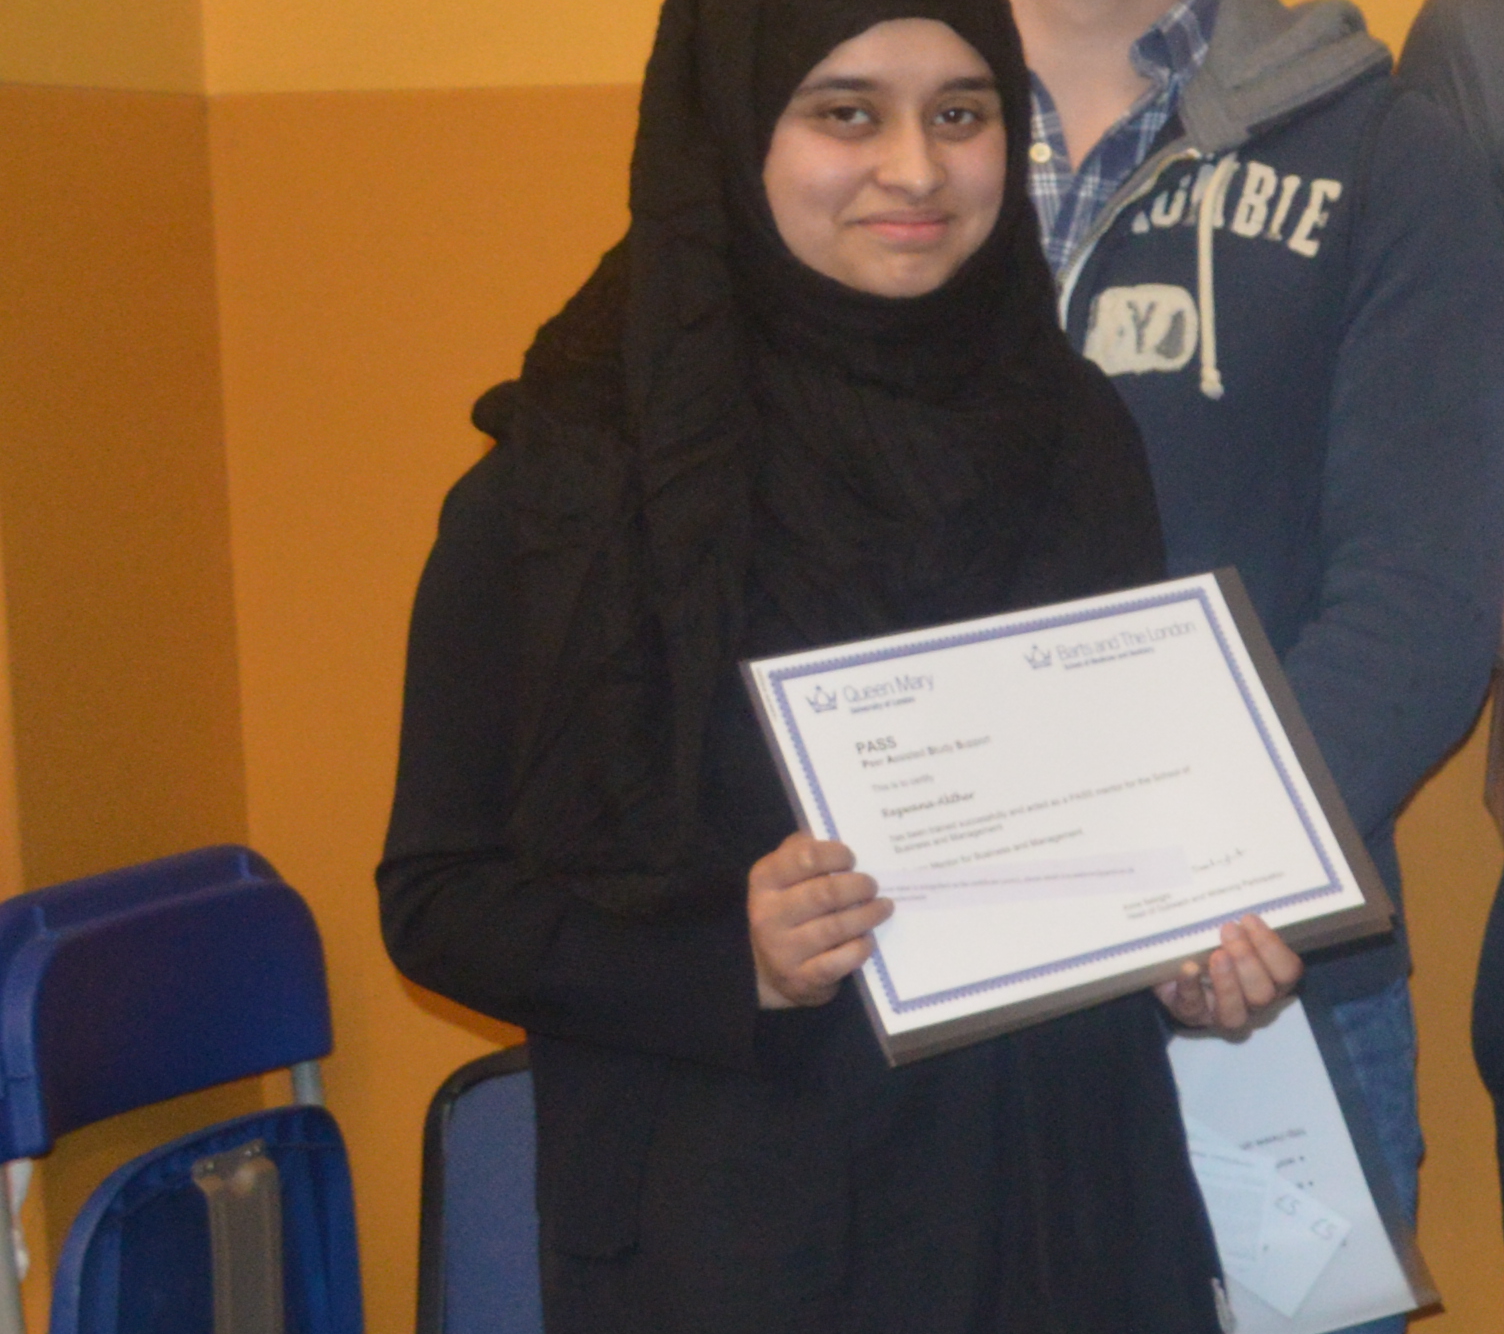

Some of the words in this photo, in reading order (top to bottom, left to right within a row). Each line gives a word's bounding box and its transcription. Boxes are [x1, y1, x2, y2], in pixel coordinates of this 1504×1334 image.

[1054, 639, 1093, 661] Barts
[1090, 633, 1122, 653] and
[1118, 627, 1149, 648] The
[1144, 618, 1198, 642] London
[840, 677, 897, 705] Queen
[893, 668, 938, 695] Mary
[853, 734, 898, 755] PASS
